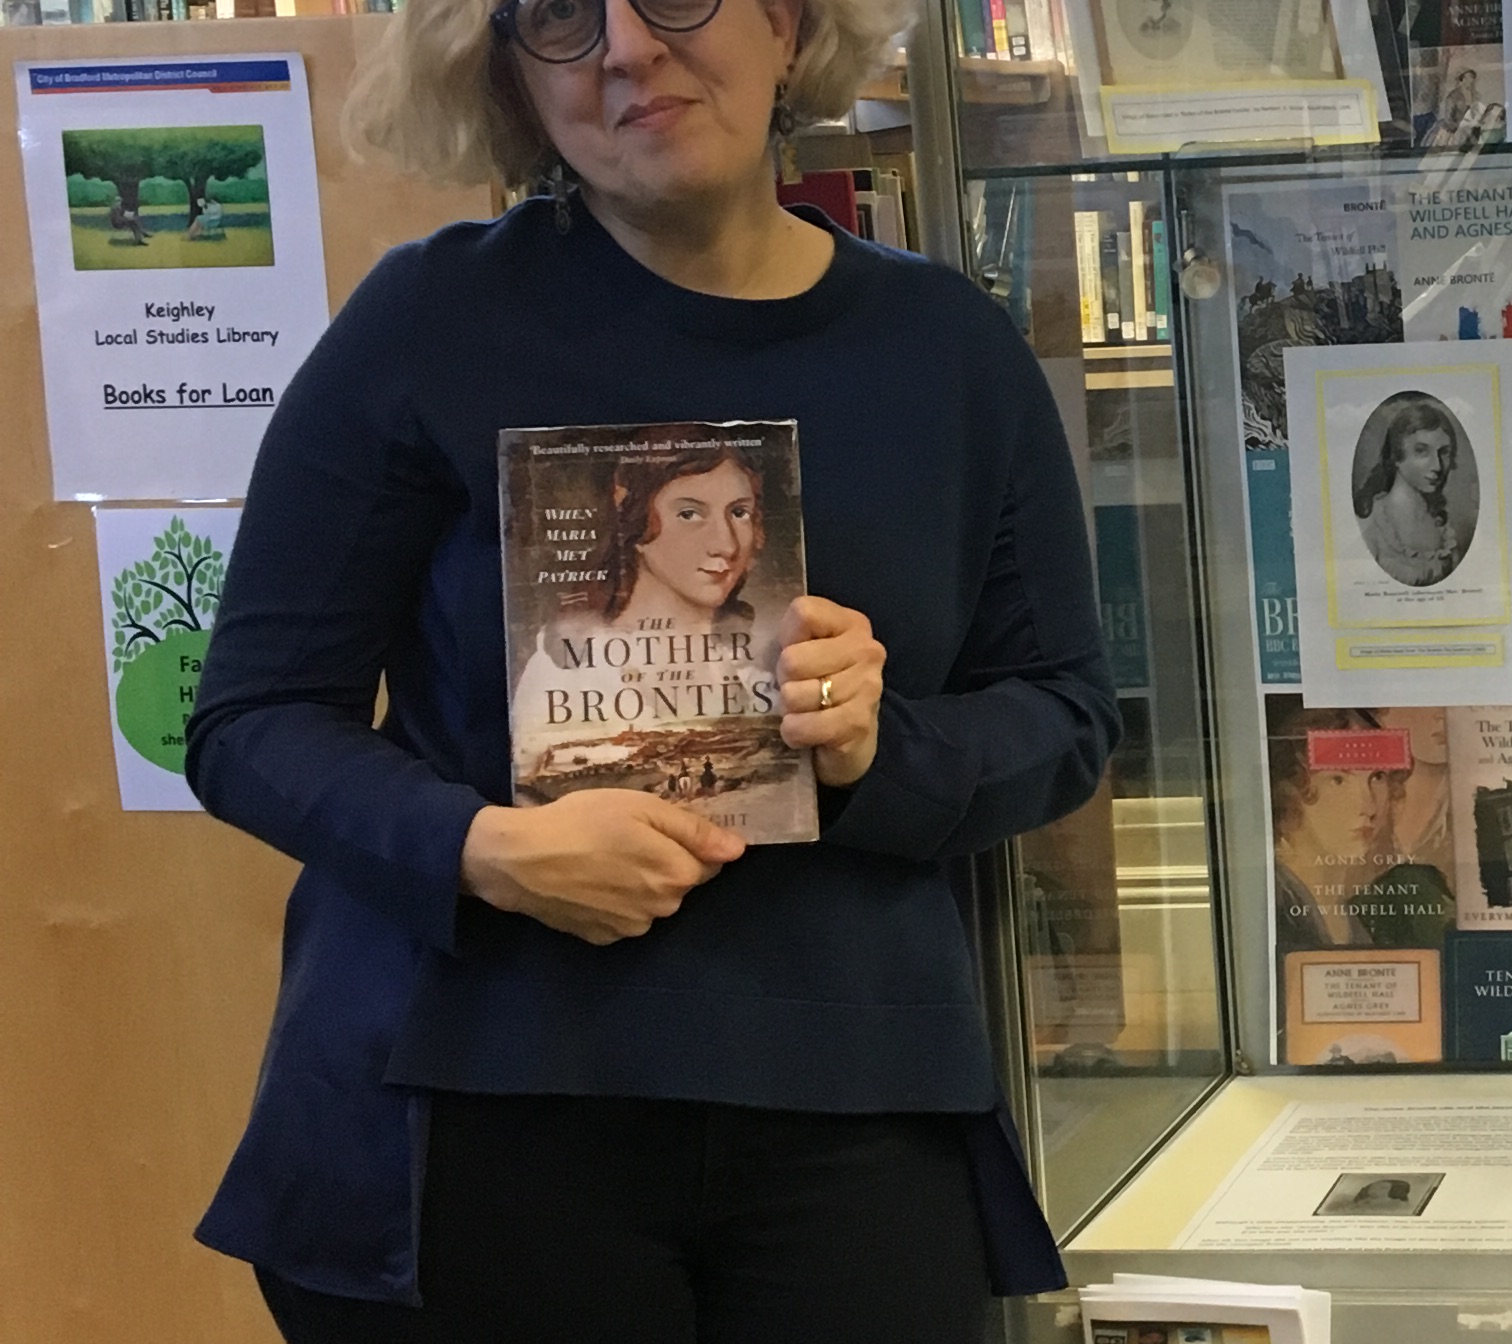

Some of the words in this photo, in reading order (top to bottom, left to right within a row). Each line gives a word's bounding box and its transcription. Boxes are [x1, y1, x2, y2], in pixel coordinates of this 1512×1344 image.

[37, 73, 53, 86] City
[54, 72, 64, 84] of
[64, 71, 100, 83] Bradford
[101, 70, 153, 82] Metropolitan
[154, 69, 184, 81] District
[185, 68, 218, 80] Council
[1408, 191, 1441, 205] THE
[1409, 206, 1490, 223] WILDFELL
[1410, 224, 1449, 240] AND
[1455, 221, 1512, 238] AGNES
[1413, 275, 1447, 287] ANNE
[145, 301, 216, 321] Keighley
[95, 329, 138, 347] Local
[146, 328, 209, 345] Studies
[217, 327, 280, 347] Library
[103, 383, 167, 405] Books
[176, 383, 212, 404] for
[222, 382, 275, 404] Loan
[593, 441, 649, 454] researched
[652, 440, 672, 451] and
[674, 438, 721, 451] vibrantly
[545, 507, 598, 521] WHEN
[545, 528, 597, 542] MARIA
[555, 548, 592, 562] MET
[537, 569, 608, 584] PATRICK
[637, 617, 677, 631] THE
[561, 631, 755, 671] MOTHER
[621, 671, 647, 685] OF
[656, 669, 696, 683] THE
[545, 674, 774, 725] BRONTËS
[1475, 719, 1502, 733] The
[1314, 855, 1367, 866] AGNES
[1373, 854, 1417, 865] GREY
[1313, 884, 1345, 896] THE
[1353, 883, 1420, 895] TENANT
[1289, 905, 1310, 917] OF
[1317, 904, 1397, 916] WILDFELL
[1403, 903, 1445, 916] HALL
[1324, 968, 1352, 977] ANNE
[1345, 982, 1382, 990] TENANT
[1332, 1002, 1363, 1010] AGNES
[1365, 1002, 1389, 1010] GREY
